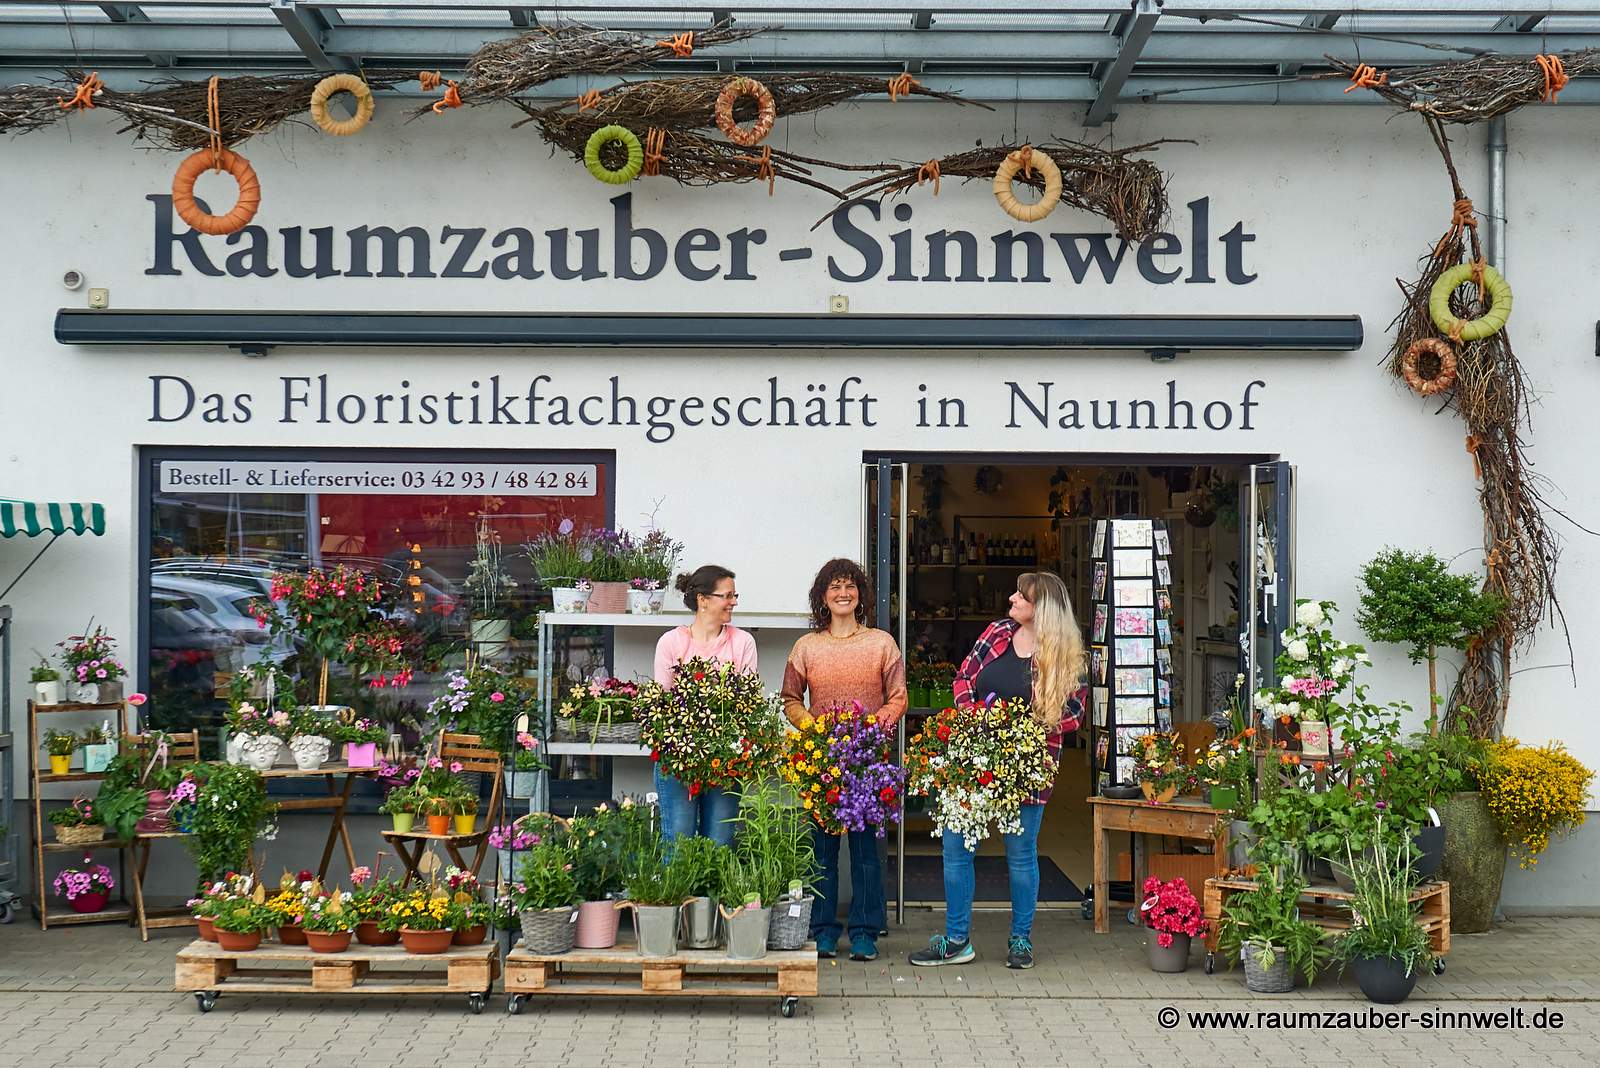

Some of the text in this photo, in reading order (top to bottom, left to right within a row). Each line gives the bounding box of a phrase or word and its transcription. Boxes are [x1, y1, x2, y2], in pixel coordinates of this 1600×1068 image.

[144, 193, 1258, 286] Raumzauber-Sinnwelt
[148, 373, 1266, 444] Das Floristikfachgeschäft in Naunhof
[168, 468, 589, 489] Bestell- & Lieferservice: 03 42 93 / 48 42 84
